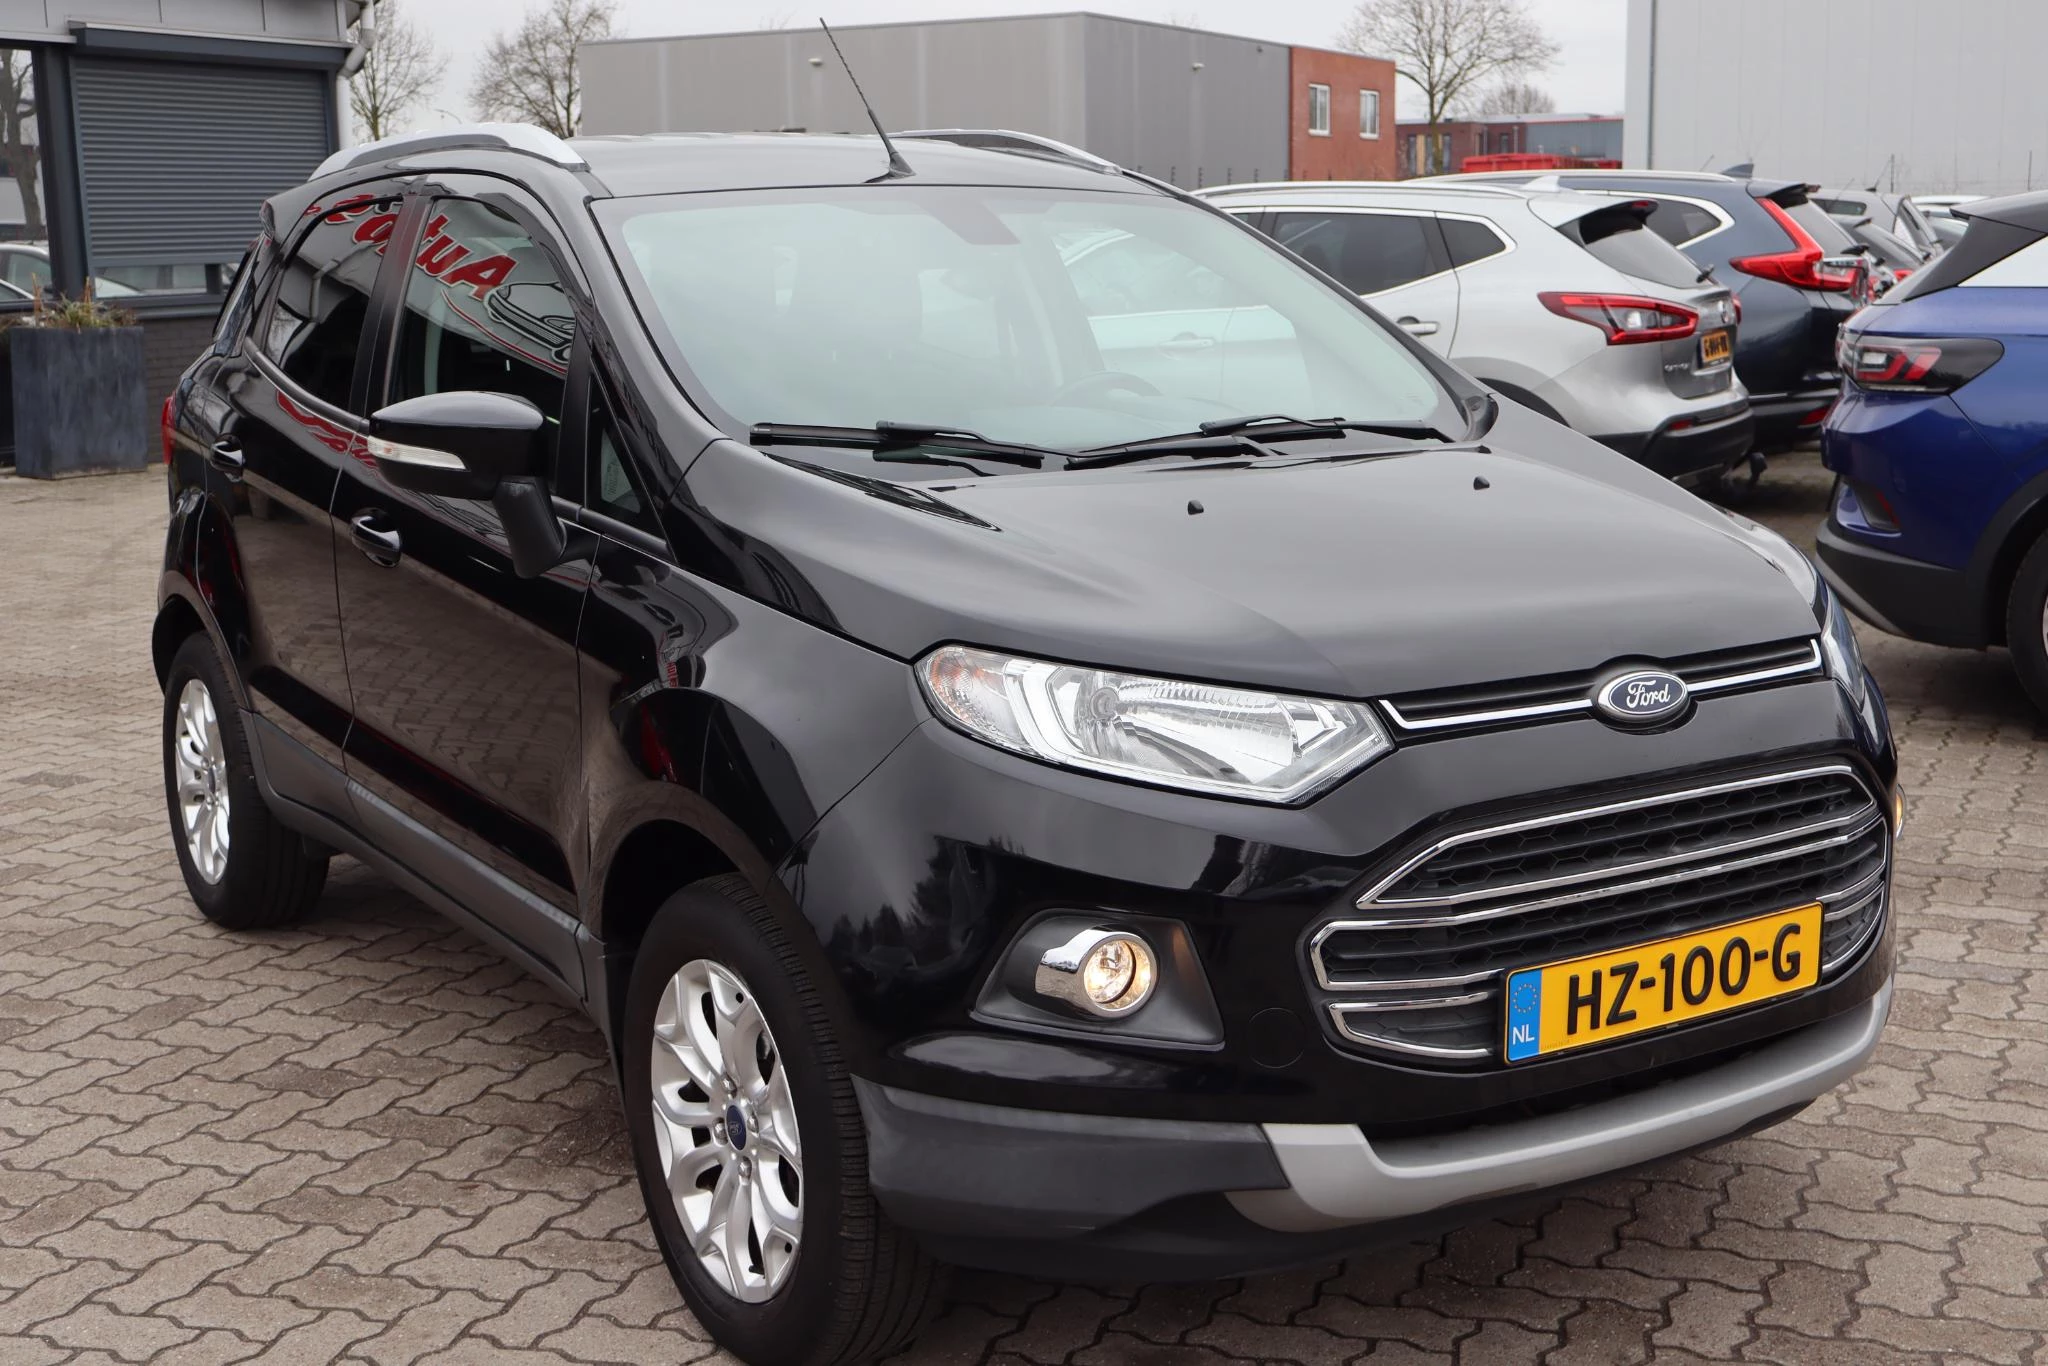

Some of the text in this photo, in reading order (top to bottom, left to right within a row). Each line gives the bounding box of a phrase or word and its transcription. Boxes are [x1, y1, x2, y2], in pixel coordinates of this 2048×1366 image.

[1626, 680, 1671, 708] Ford
[1566, 922, 1801, 1036] HZ-100-G
[1512, 1024, 1535, 1045] NL
